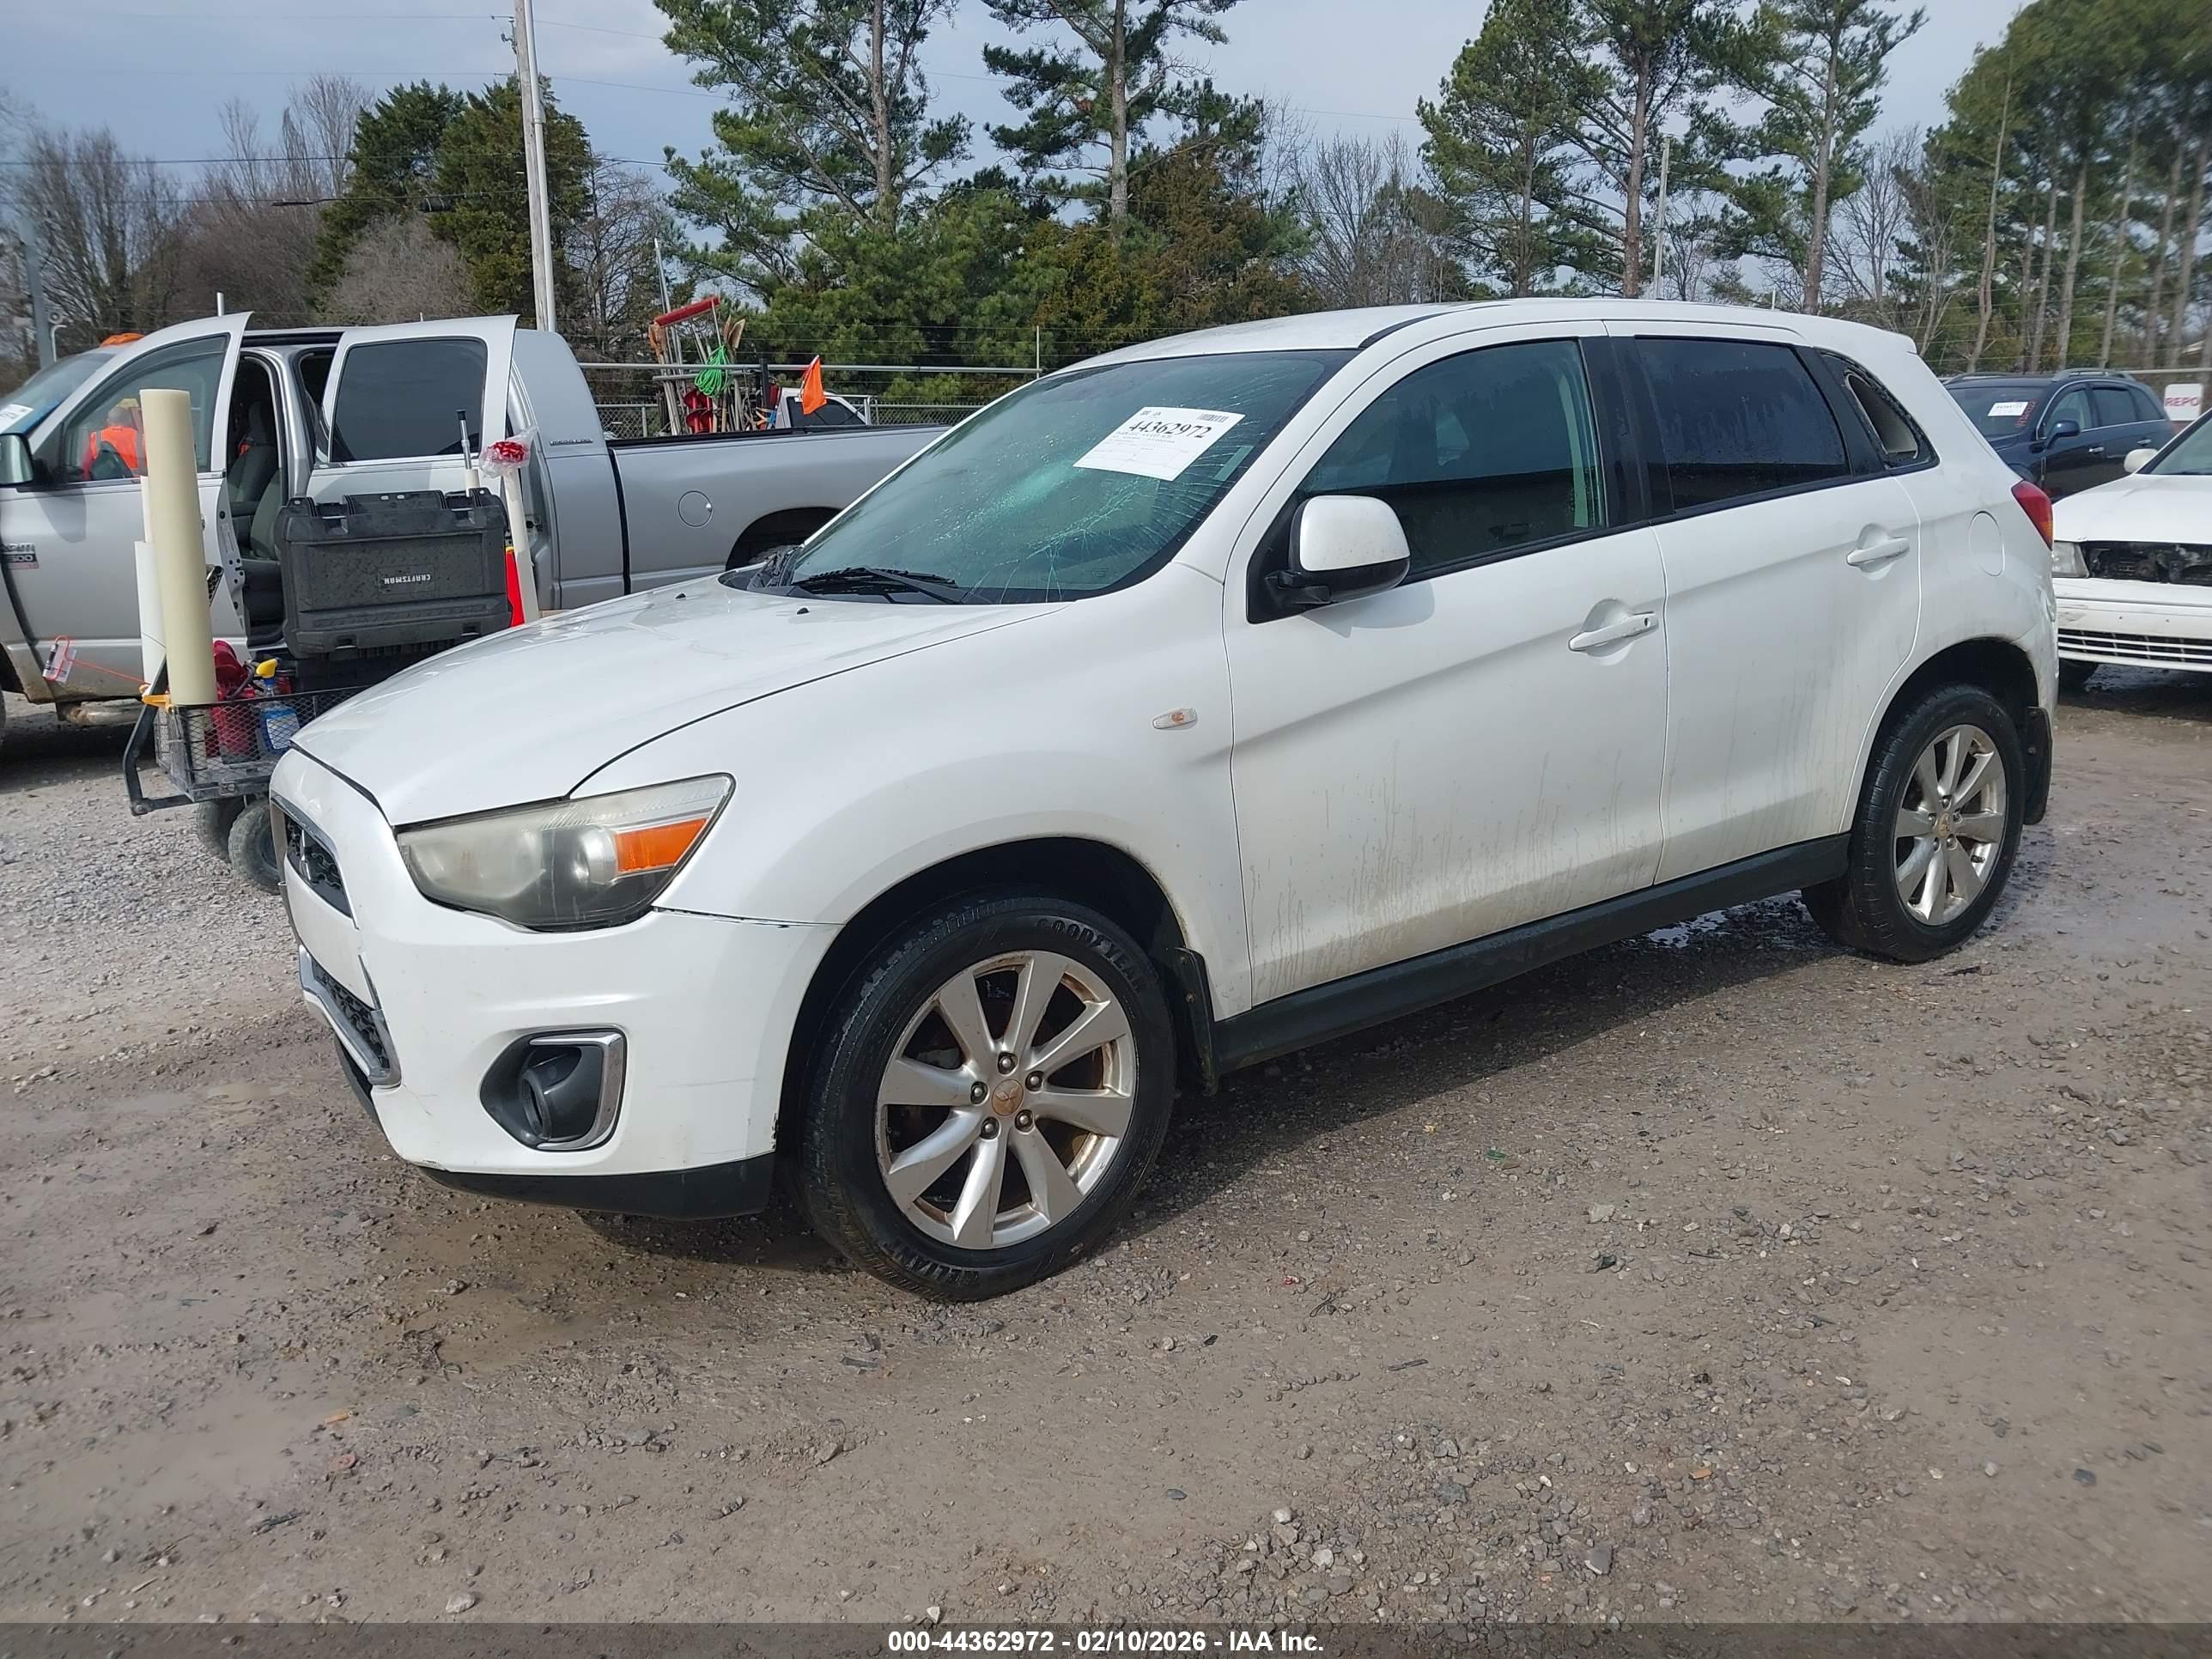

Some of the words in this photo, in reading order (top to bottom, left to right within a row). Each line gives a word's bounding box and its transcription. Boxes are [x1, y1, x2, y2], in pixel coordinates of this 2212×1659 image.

[2164, 397, 2199, 406] REPO
[1129, 421, 1212, 438] 44362972
[384, 574, 431, 585] CRAFTSMAN
